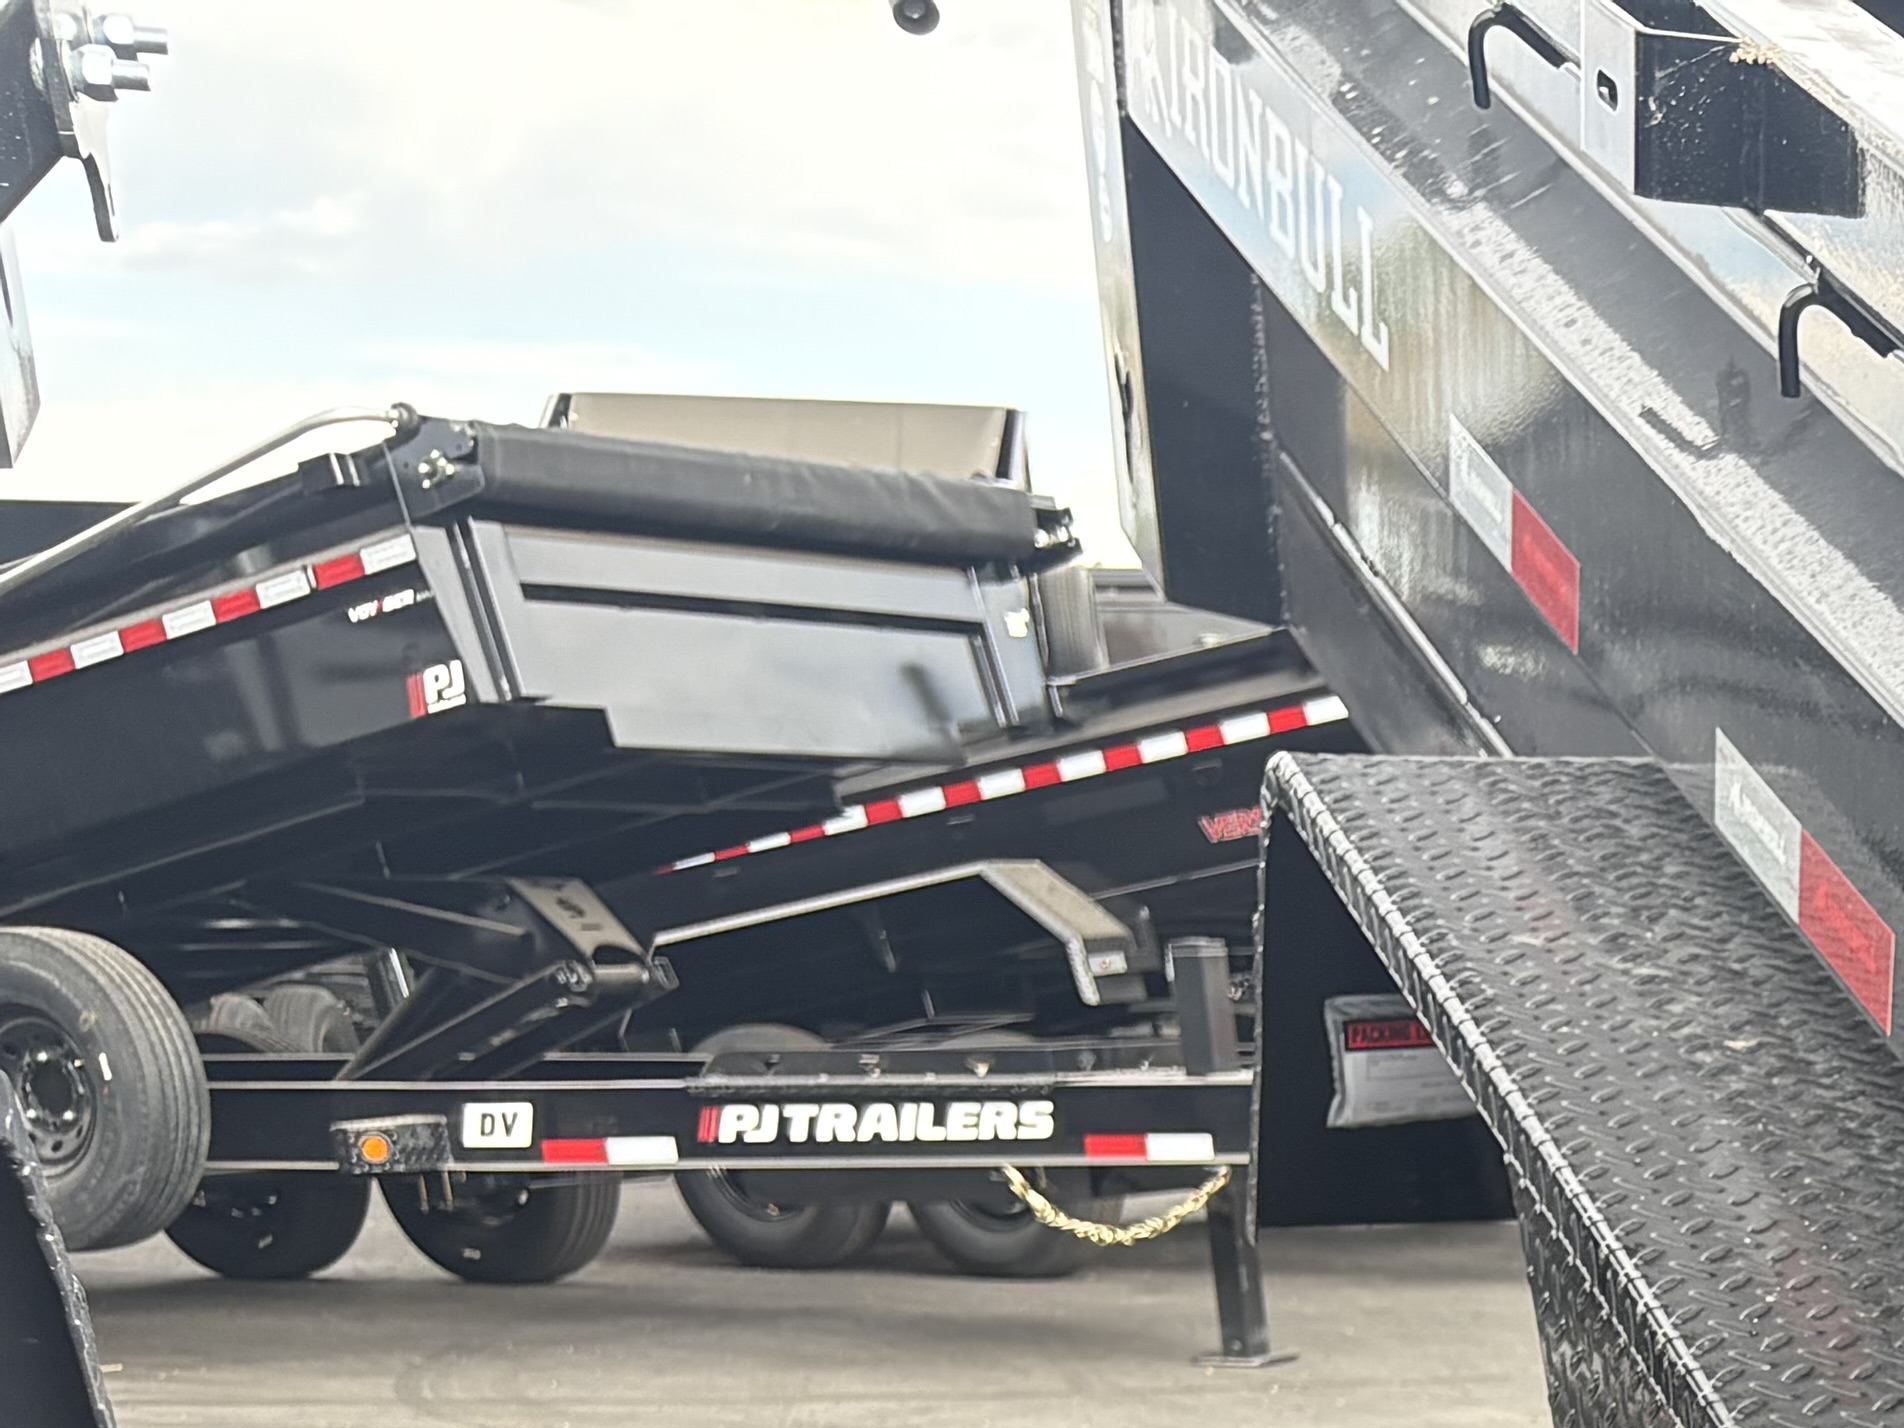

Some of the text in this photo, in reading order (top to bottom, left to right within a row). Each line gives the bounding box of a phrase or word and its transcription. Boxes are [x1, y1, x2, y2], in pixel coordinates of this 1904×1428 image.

[1167, 2, 1390, 373] IRONBULL
[422, 659, 465, 705] PJ
[480, 1111, 518, 1138] DV
[718, 1100, 1055, 1145] PJ TRAILERS
